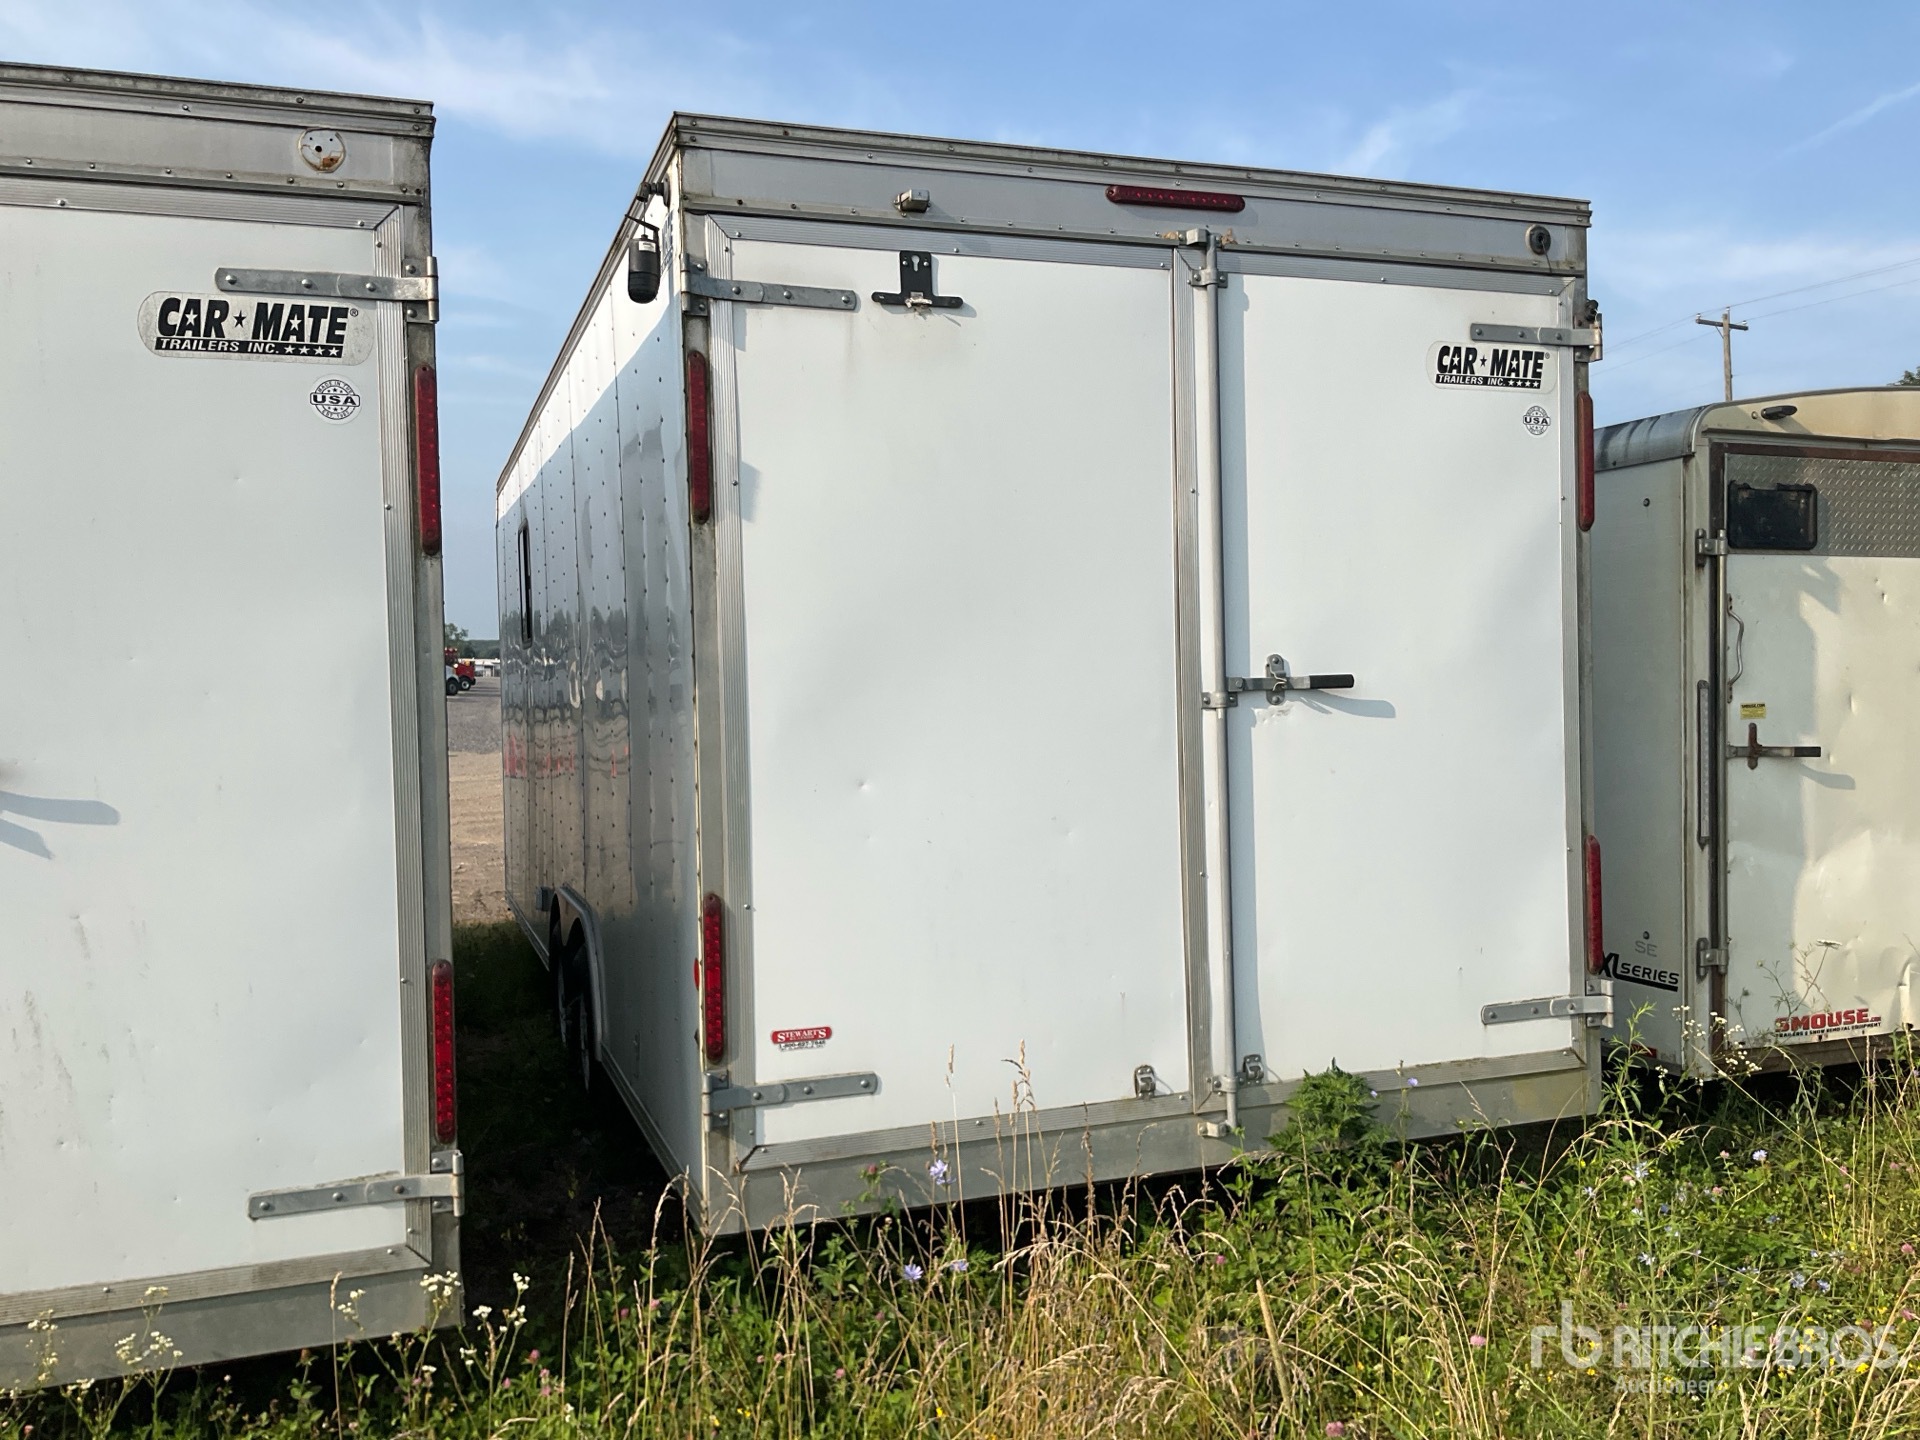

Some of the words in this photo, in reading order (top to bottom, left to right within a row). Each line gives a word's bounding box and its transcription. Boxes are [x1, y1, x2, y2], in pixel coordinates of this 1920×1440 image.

[157, 297, 230, 339] CAR
[160, 338, 240, 352] TRAILERS
[247, 342, 280, 354] INC.
[1437, 345, 1478, 375] CAR
[1438, 374, 1484, 385] TRAILERS
[1487, 377, 1506, 387] INC.
[312, 394, 357, 406] USA
[1524, 416, 1549, 425] USA
[1634, 940, 1658, 958] SE
[1620, 962, 1680, 985] SERIES
